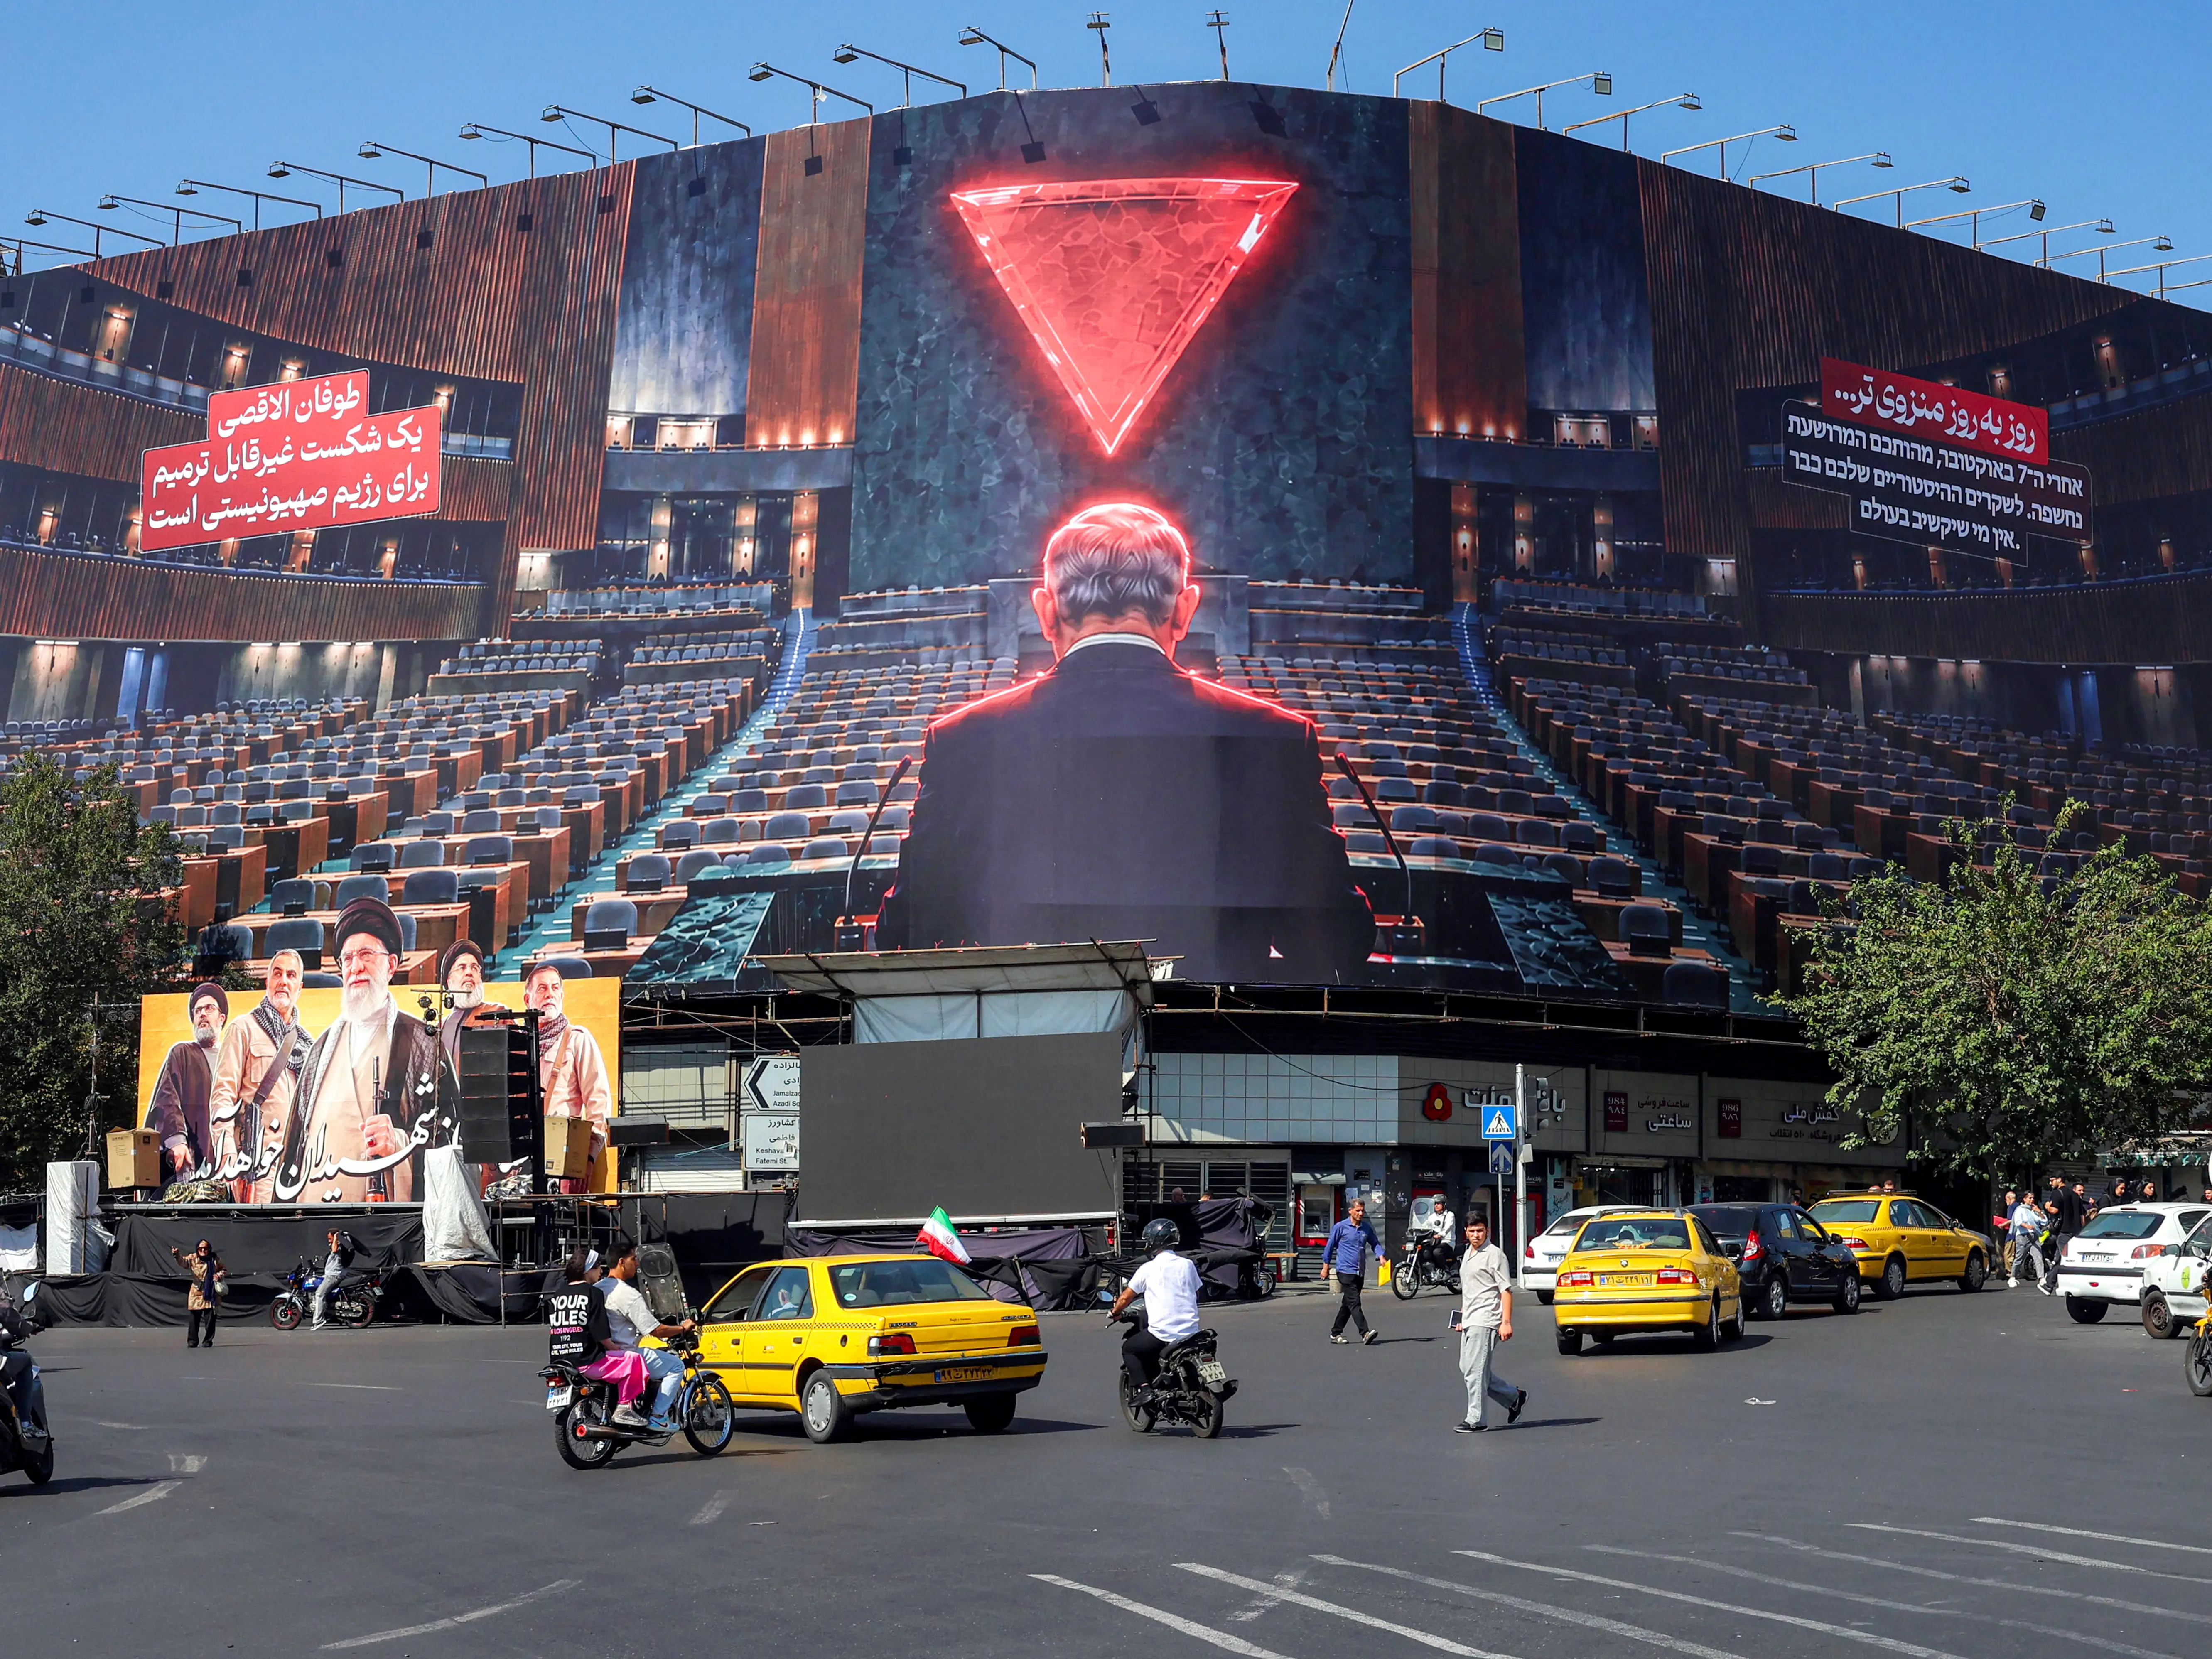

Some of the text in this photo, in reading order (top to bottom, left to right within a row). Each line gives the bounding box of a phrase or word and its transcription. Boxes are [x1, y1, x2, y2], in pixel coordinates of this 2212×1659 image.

[218, 378, 360, 438] طوفان الاقصی
[1876, 385, 1944, 426] منزوی
[1944, 400, 1978, 440] روز
[1788, 415, 1866, 449] המרושעת
[1980, 407, 2002, 445] به
[2003, 414, 2035, 454] روز
[152, 414, 422, 498] یک شکست غیرقابل ترمیم
[1869, 433, 1933, 464] מהותכם
[1936, 449, 2014, 482] באוקטובר,
[149, 461, 429, 531] برای رژیم صهیونیستی است
[1789, 450, 2082, 529] נחשפה. לשקרים ההיסטוריים שלכם כבר
[2046, 473, 2083, 497] אחרי
[1860, 496, 1910, 527] בעולם
[1912, 510, 1969, 540] שיקשיב
[1972, 523, 1989, 543] מי
[774, 1062, 800, 1070] الزاده
[1608, 1097, 1625, 1105] 984
[1722, 1104, 1738, 1112] 986
[1784, 1103, 1806, 1123] ملی
[768, 1119, 795, 1128] کشاورز
[1648, 1113, 1692, 1132] ساعتی
[769, 1134, 795, 1143] فاطمی
[551, 1294, 589, 1311] YOUR
